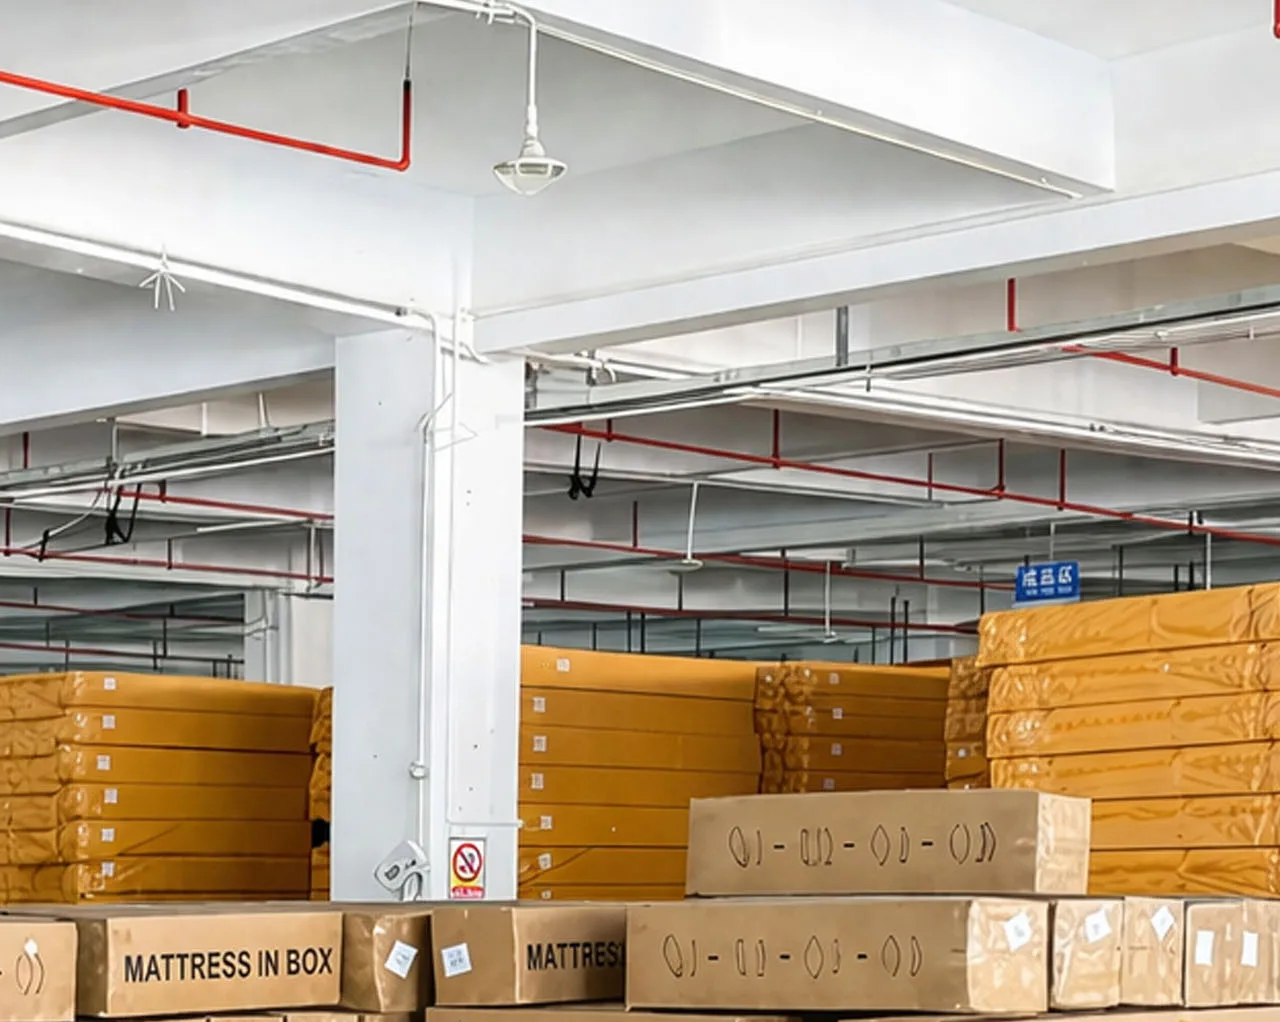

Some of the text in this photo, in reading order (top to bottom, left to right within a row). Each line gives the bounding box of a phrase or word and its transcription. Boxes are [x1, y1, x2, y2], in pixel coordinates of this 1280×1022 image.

[124, 947, 333, 982] MATTRESS IN BOX
[527, 941, 624, 970] MATTRES
